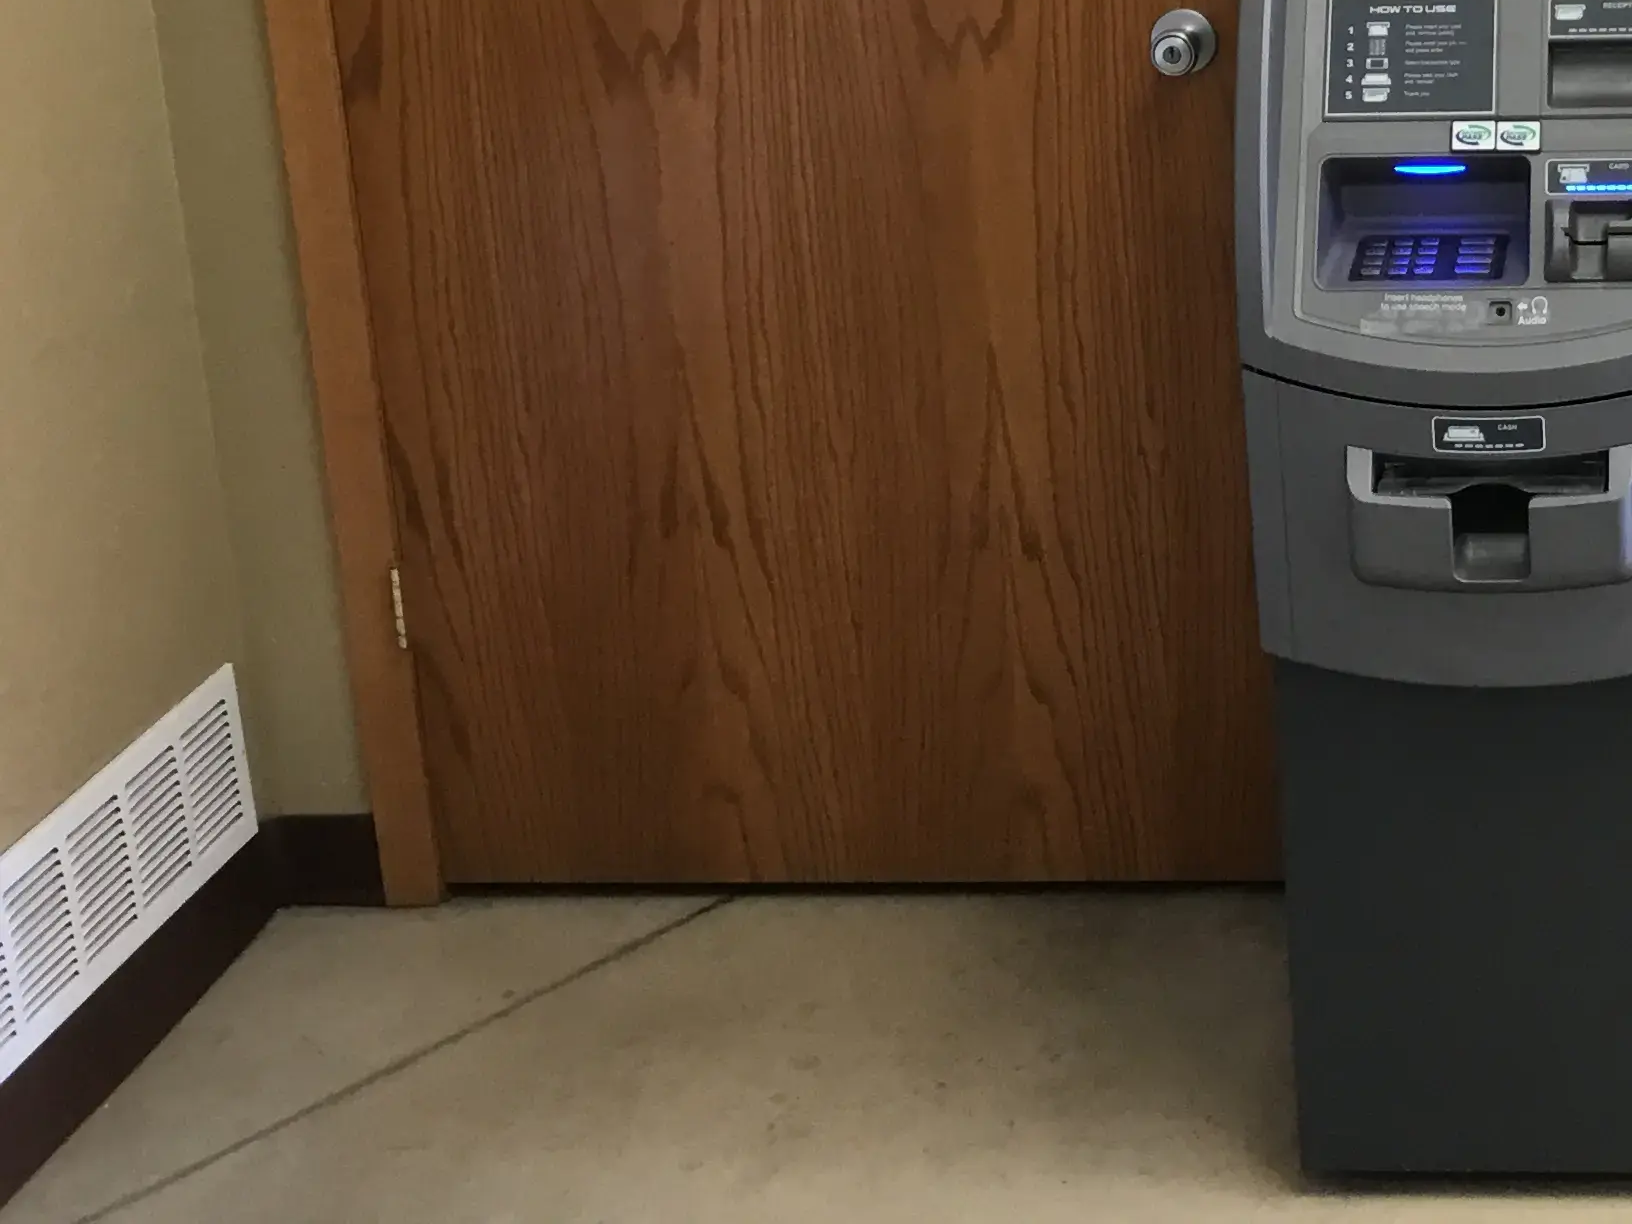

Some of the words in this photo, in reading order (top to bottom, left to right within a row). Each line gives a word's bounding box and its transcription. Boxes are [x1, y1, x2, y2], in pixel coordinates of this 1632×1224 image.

[1369, 5, 1401, 14] HOW
[1403, 5, 1423, 14] TO
[1425, 4, 1457, 13] USE
[1602, 1, 1632, 9] RECEIPT
[1347, 26, 1354, 35] 1
[1346, 42, 1355, 52] 2
[1346, 59, 1354, 68] 3
[1345, 75, 1353, 84] 4
[1345, 91, 1353, 100] 5
[1517, 315, 1548, 326] Audio
